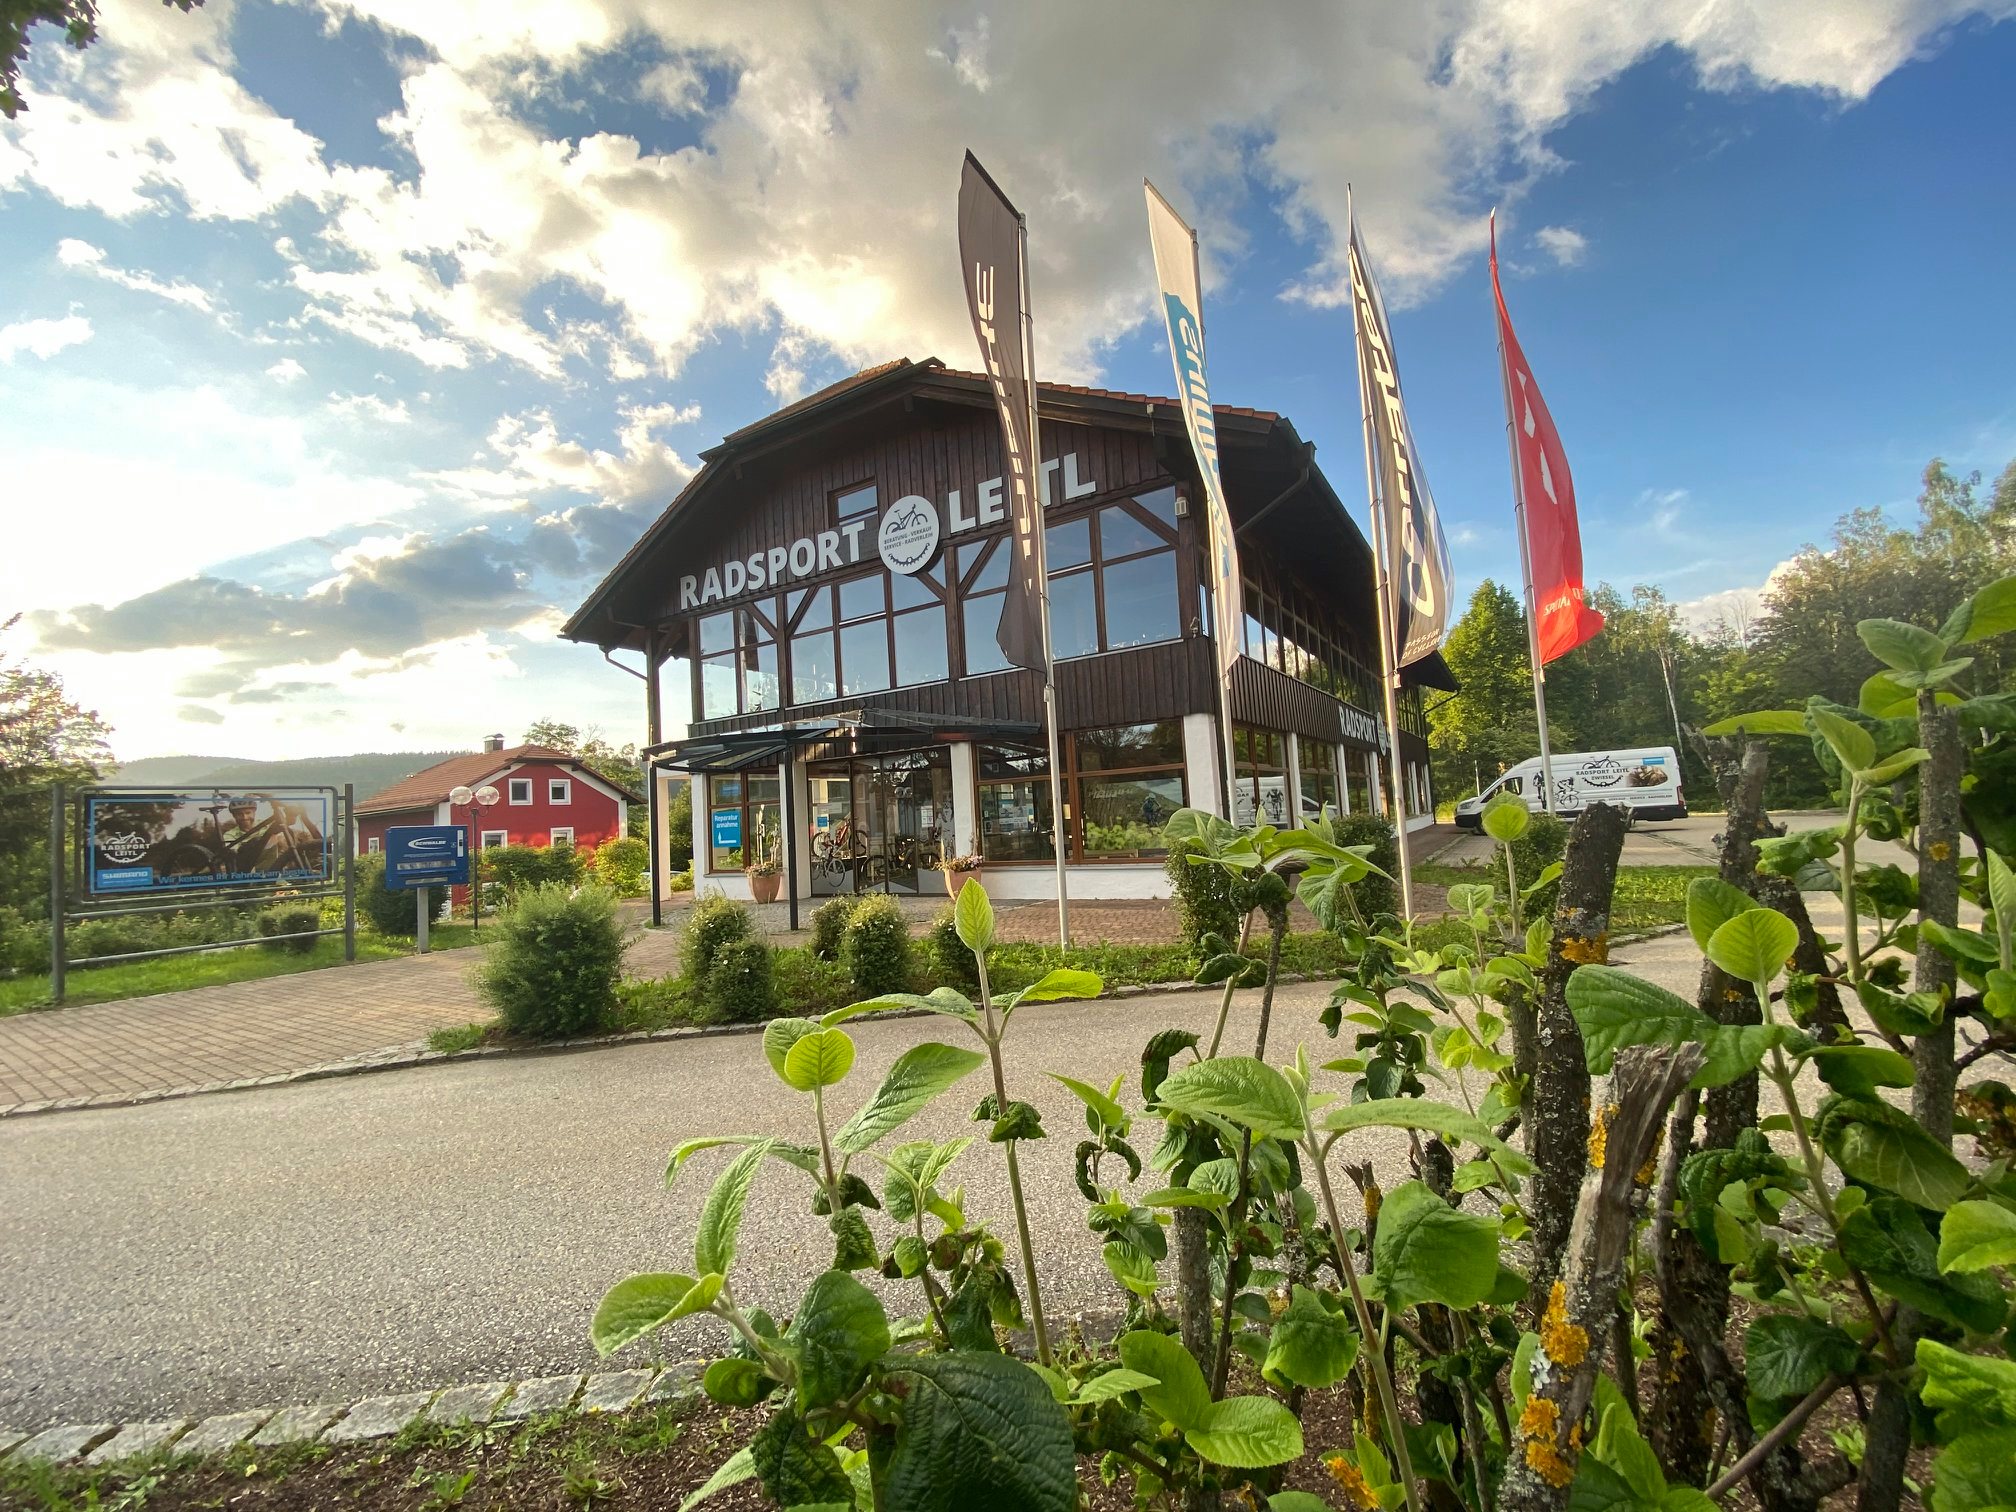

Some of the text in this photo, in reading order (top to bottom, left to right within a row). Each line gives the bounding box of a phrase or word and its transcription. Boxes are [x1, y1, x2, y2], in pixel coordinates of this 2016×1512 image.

[949, 452, 1096, 534] LETL
[884, 526, 932, 545] BERATUNG VERKAUF
[884, 532, 933, 551] SERVICE RADVERLEIH
[680, 521, 865, 610] RADSPORT
[1338, 705, 1377, 744] RADSPORT
[714, 814, 738, 822] Reparatur
[101, 843, 151, 851] RADSPORT
[102, 870, 148, 879] SHIMANO
